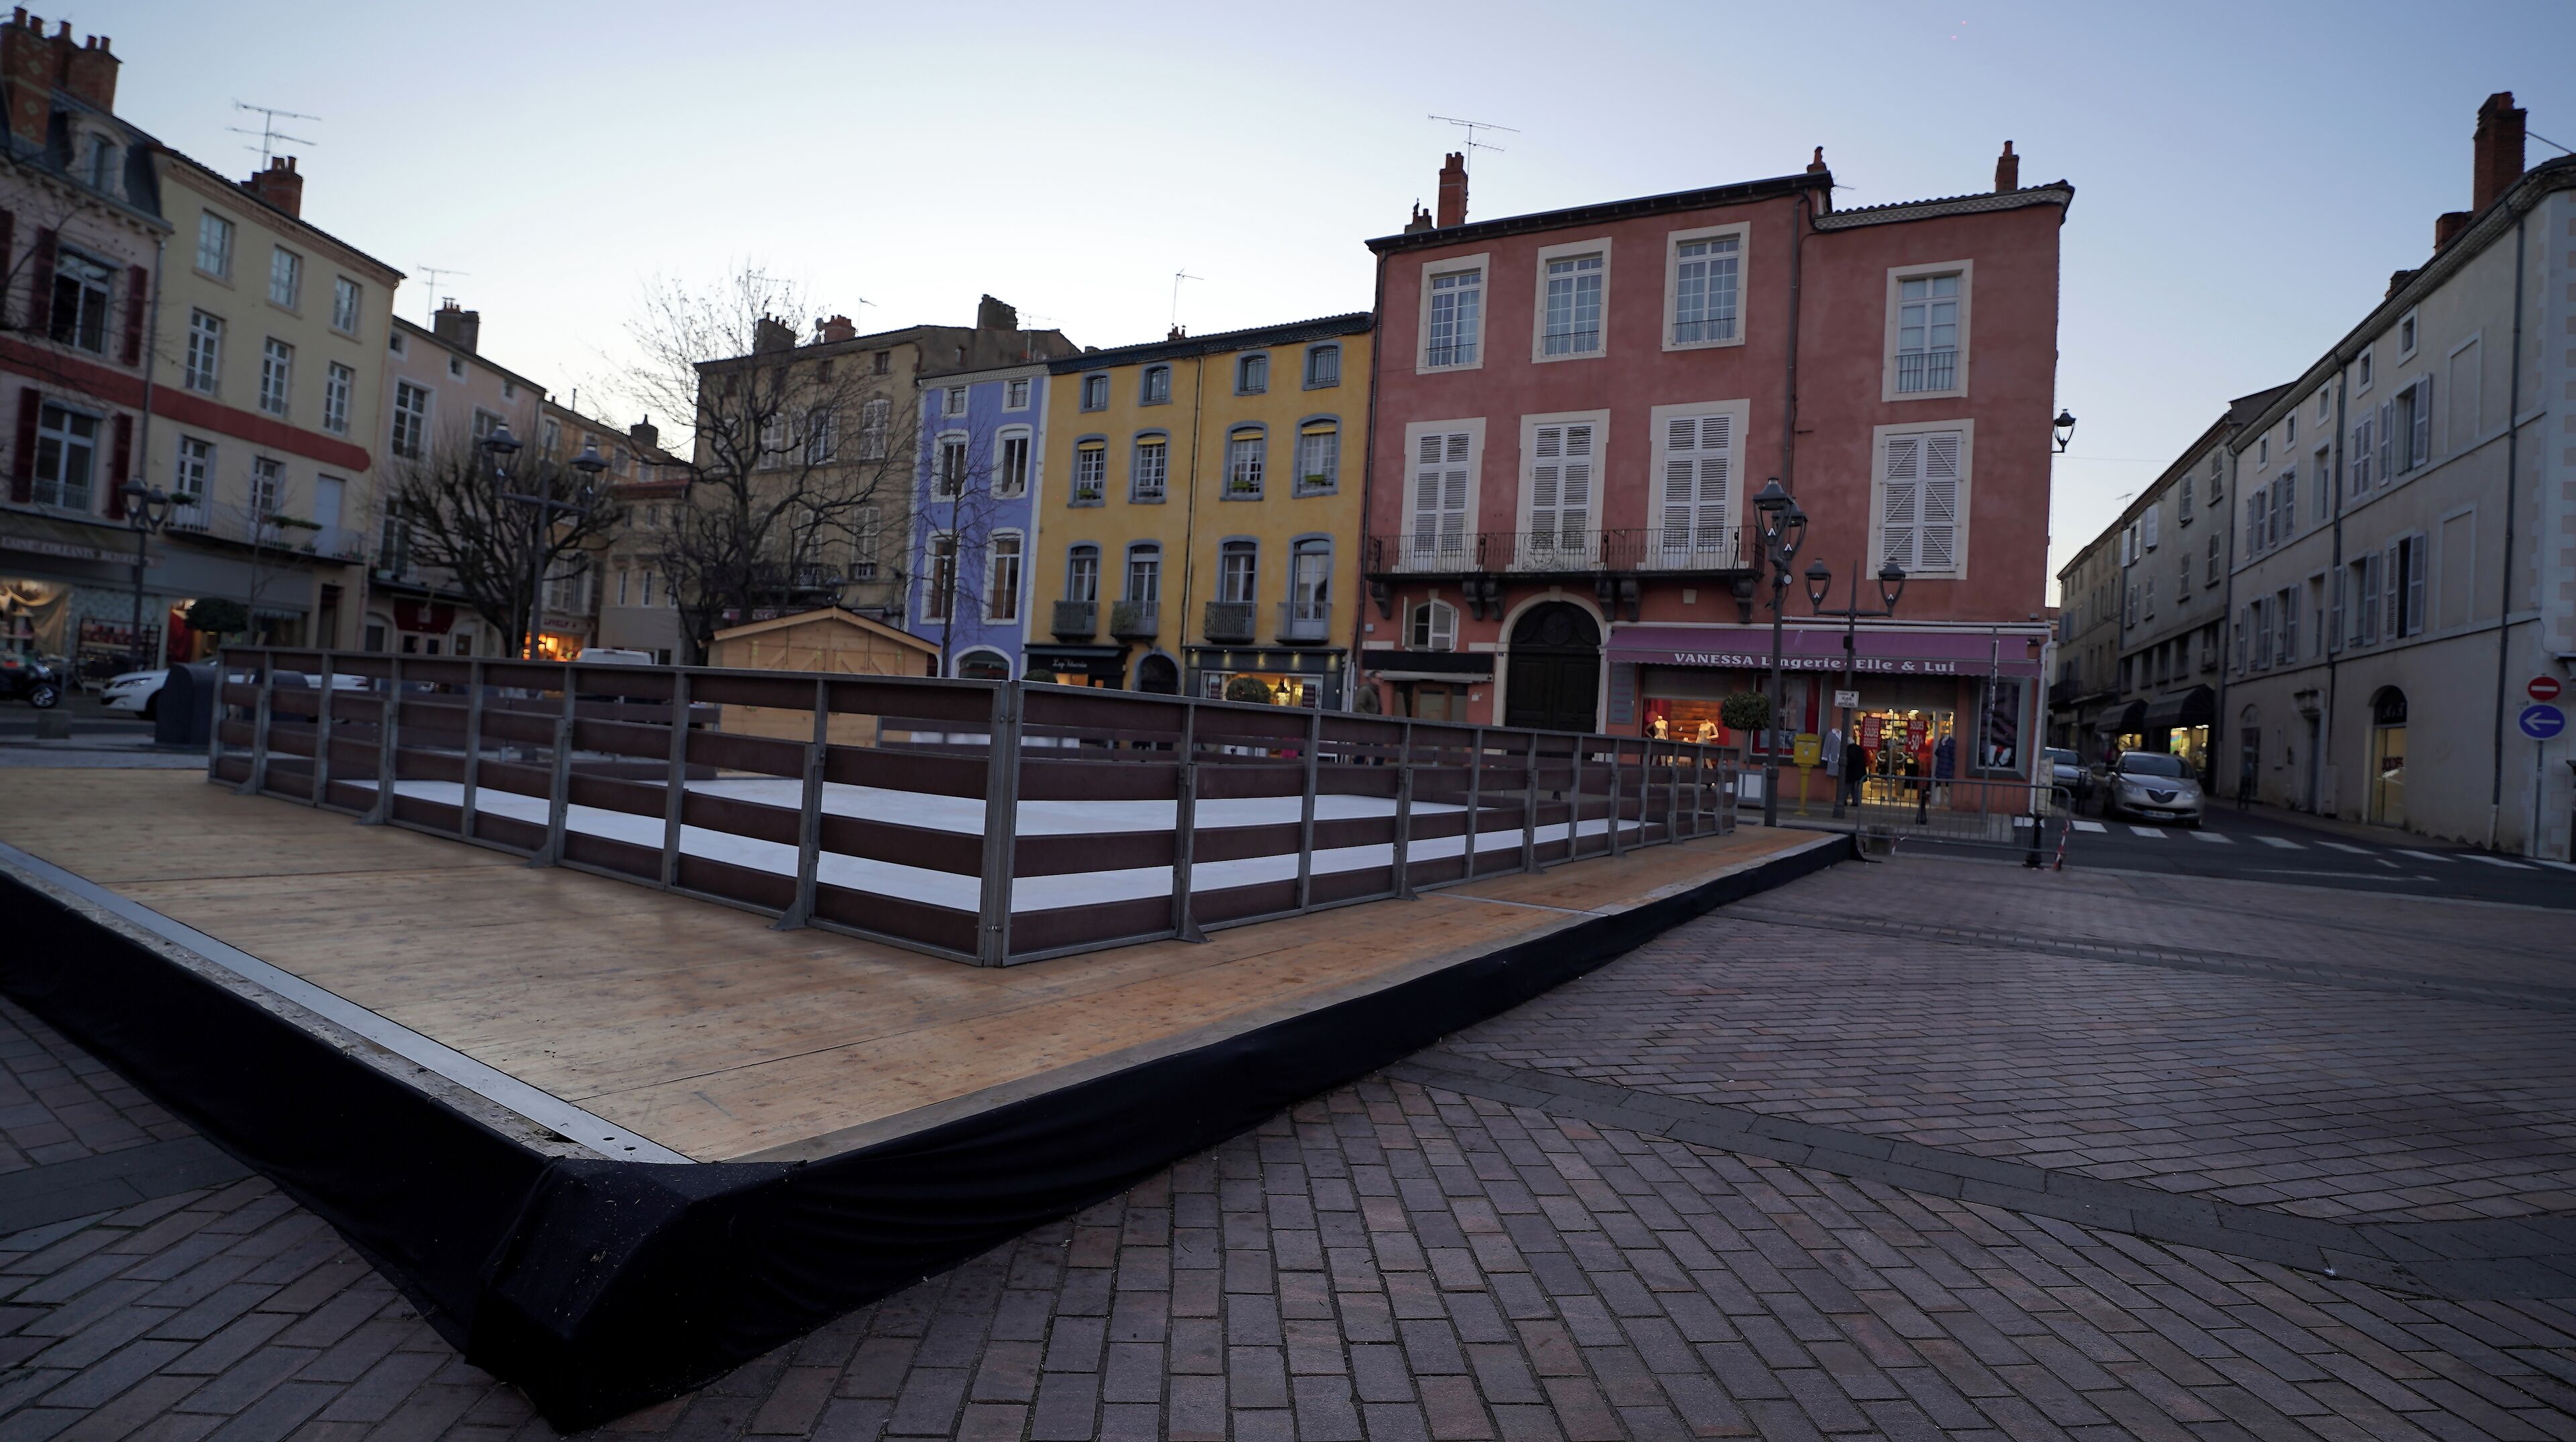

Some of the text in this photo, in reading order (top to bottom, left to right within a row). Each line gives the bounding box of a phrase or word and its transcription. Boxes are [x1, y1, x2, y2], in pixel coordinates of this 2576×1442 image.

[1674, 653, 1955, 673] VANESSA Lngerie Elle & Lui
